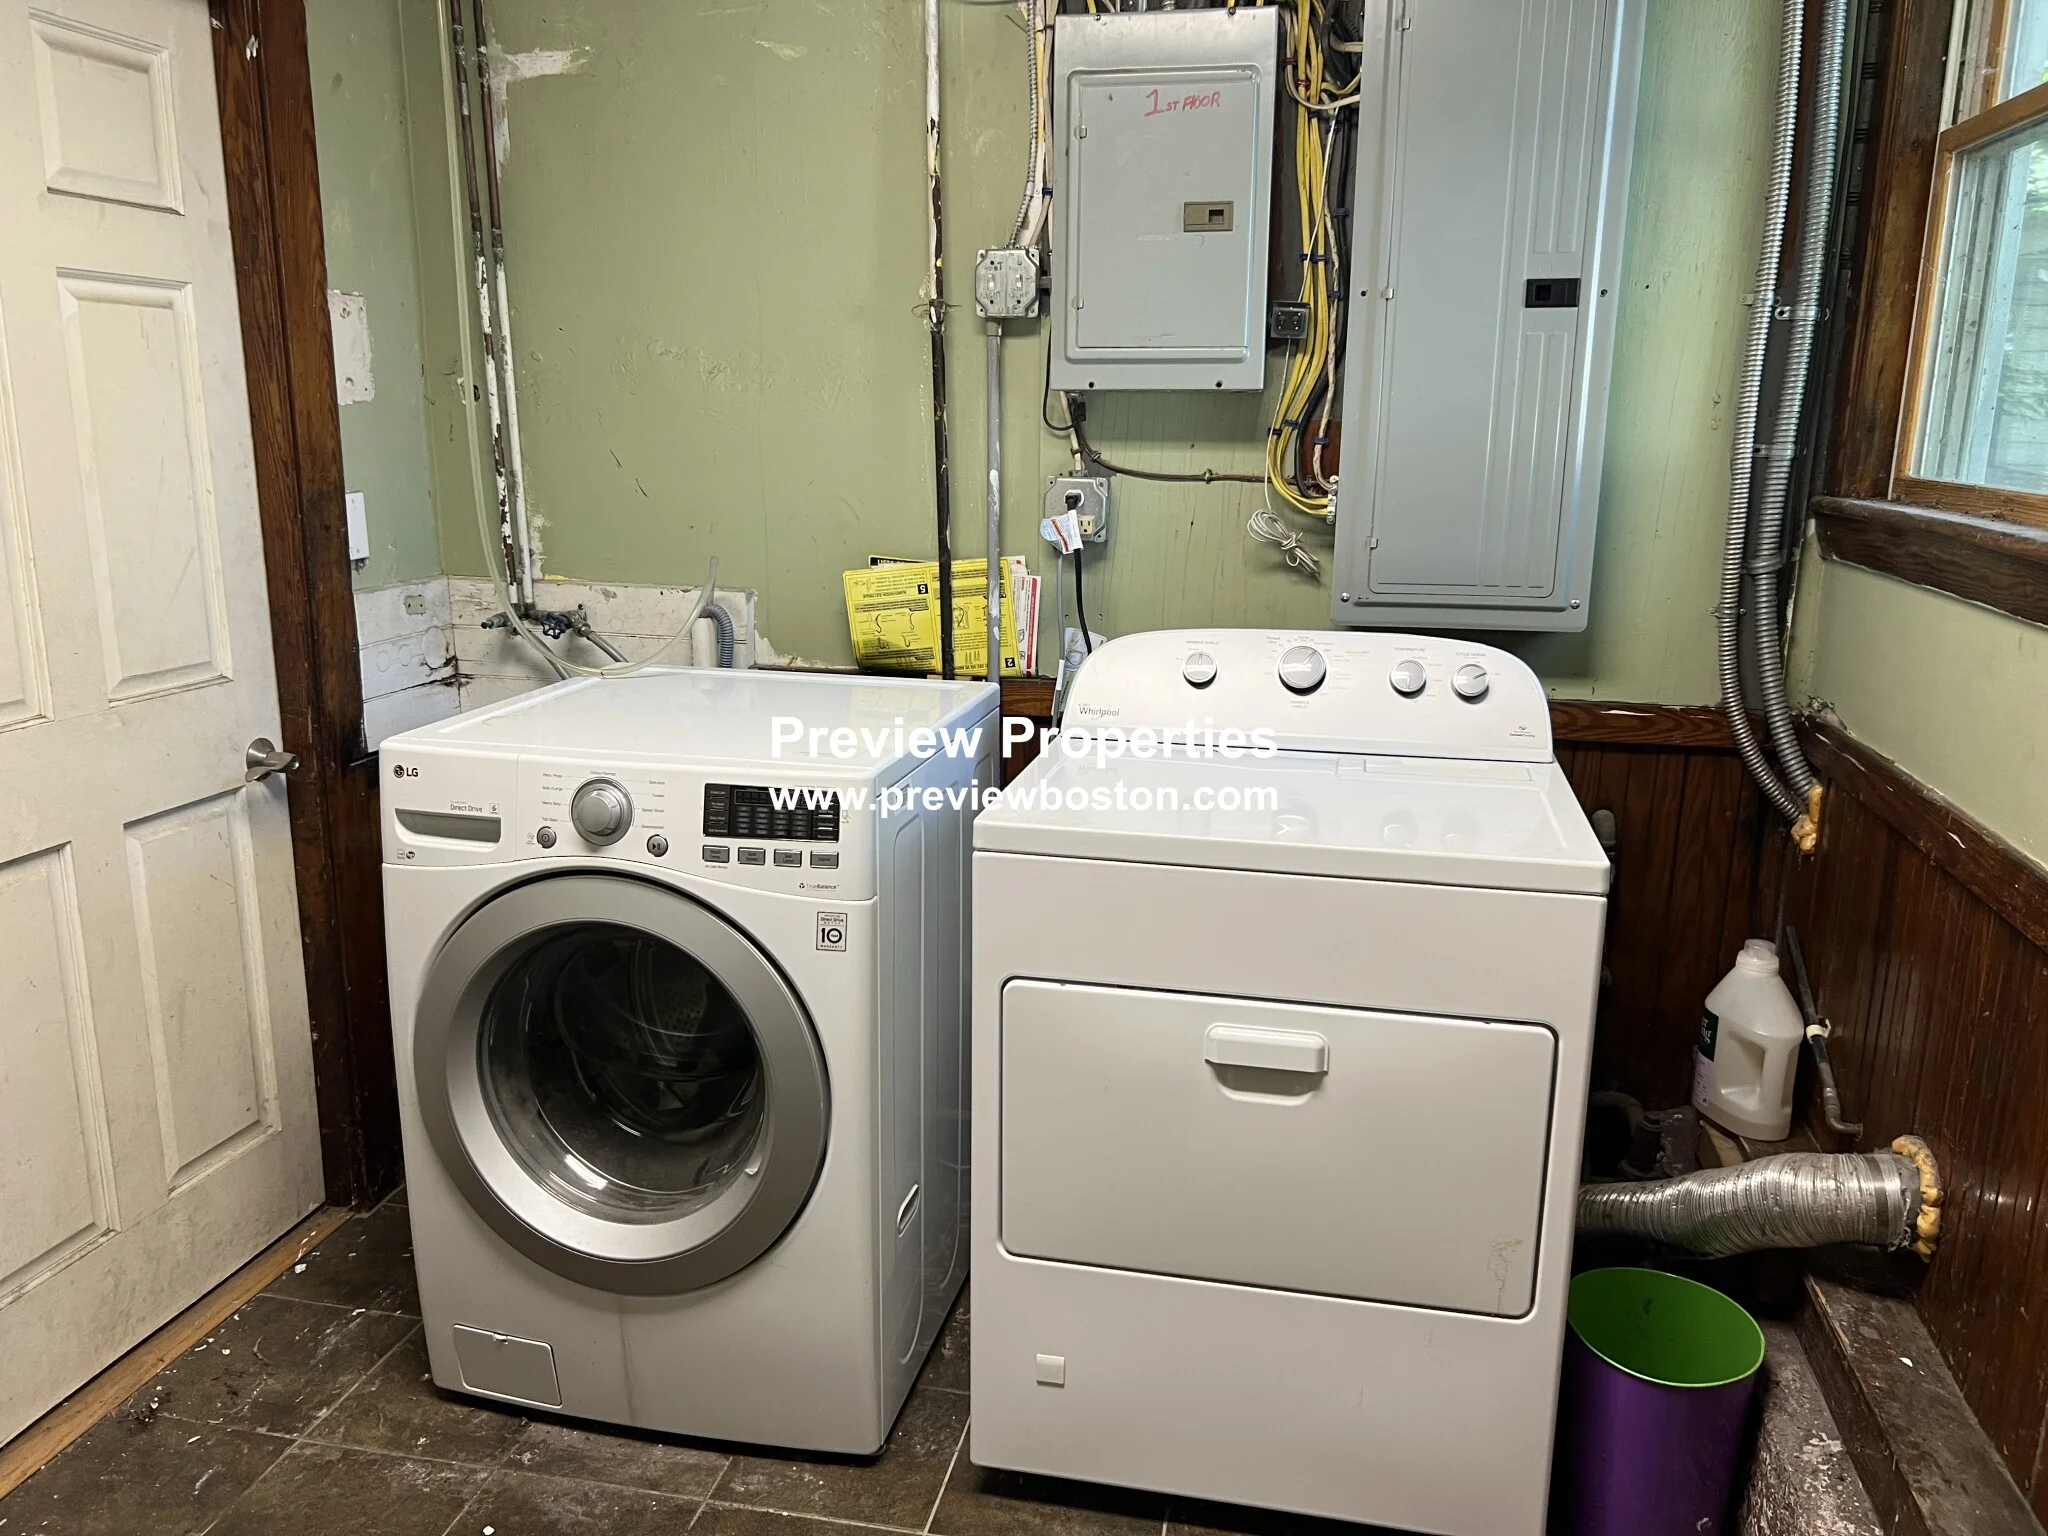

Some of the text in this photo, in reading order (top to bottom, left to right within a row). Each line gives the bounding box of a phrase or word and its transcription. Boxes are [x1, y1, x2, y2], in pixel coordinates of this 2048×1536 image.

[1078, 707, 1120, 718] Whirlpool
[450, 803, 483, 813] Direct Drive
[821, 927, 843, 944] 10
